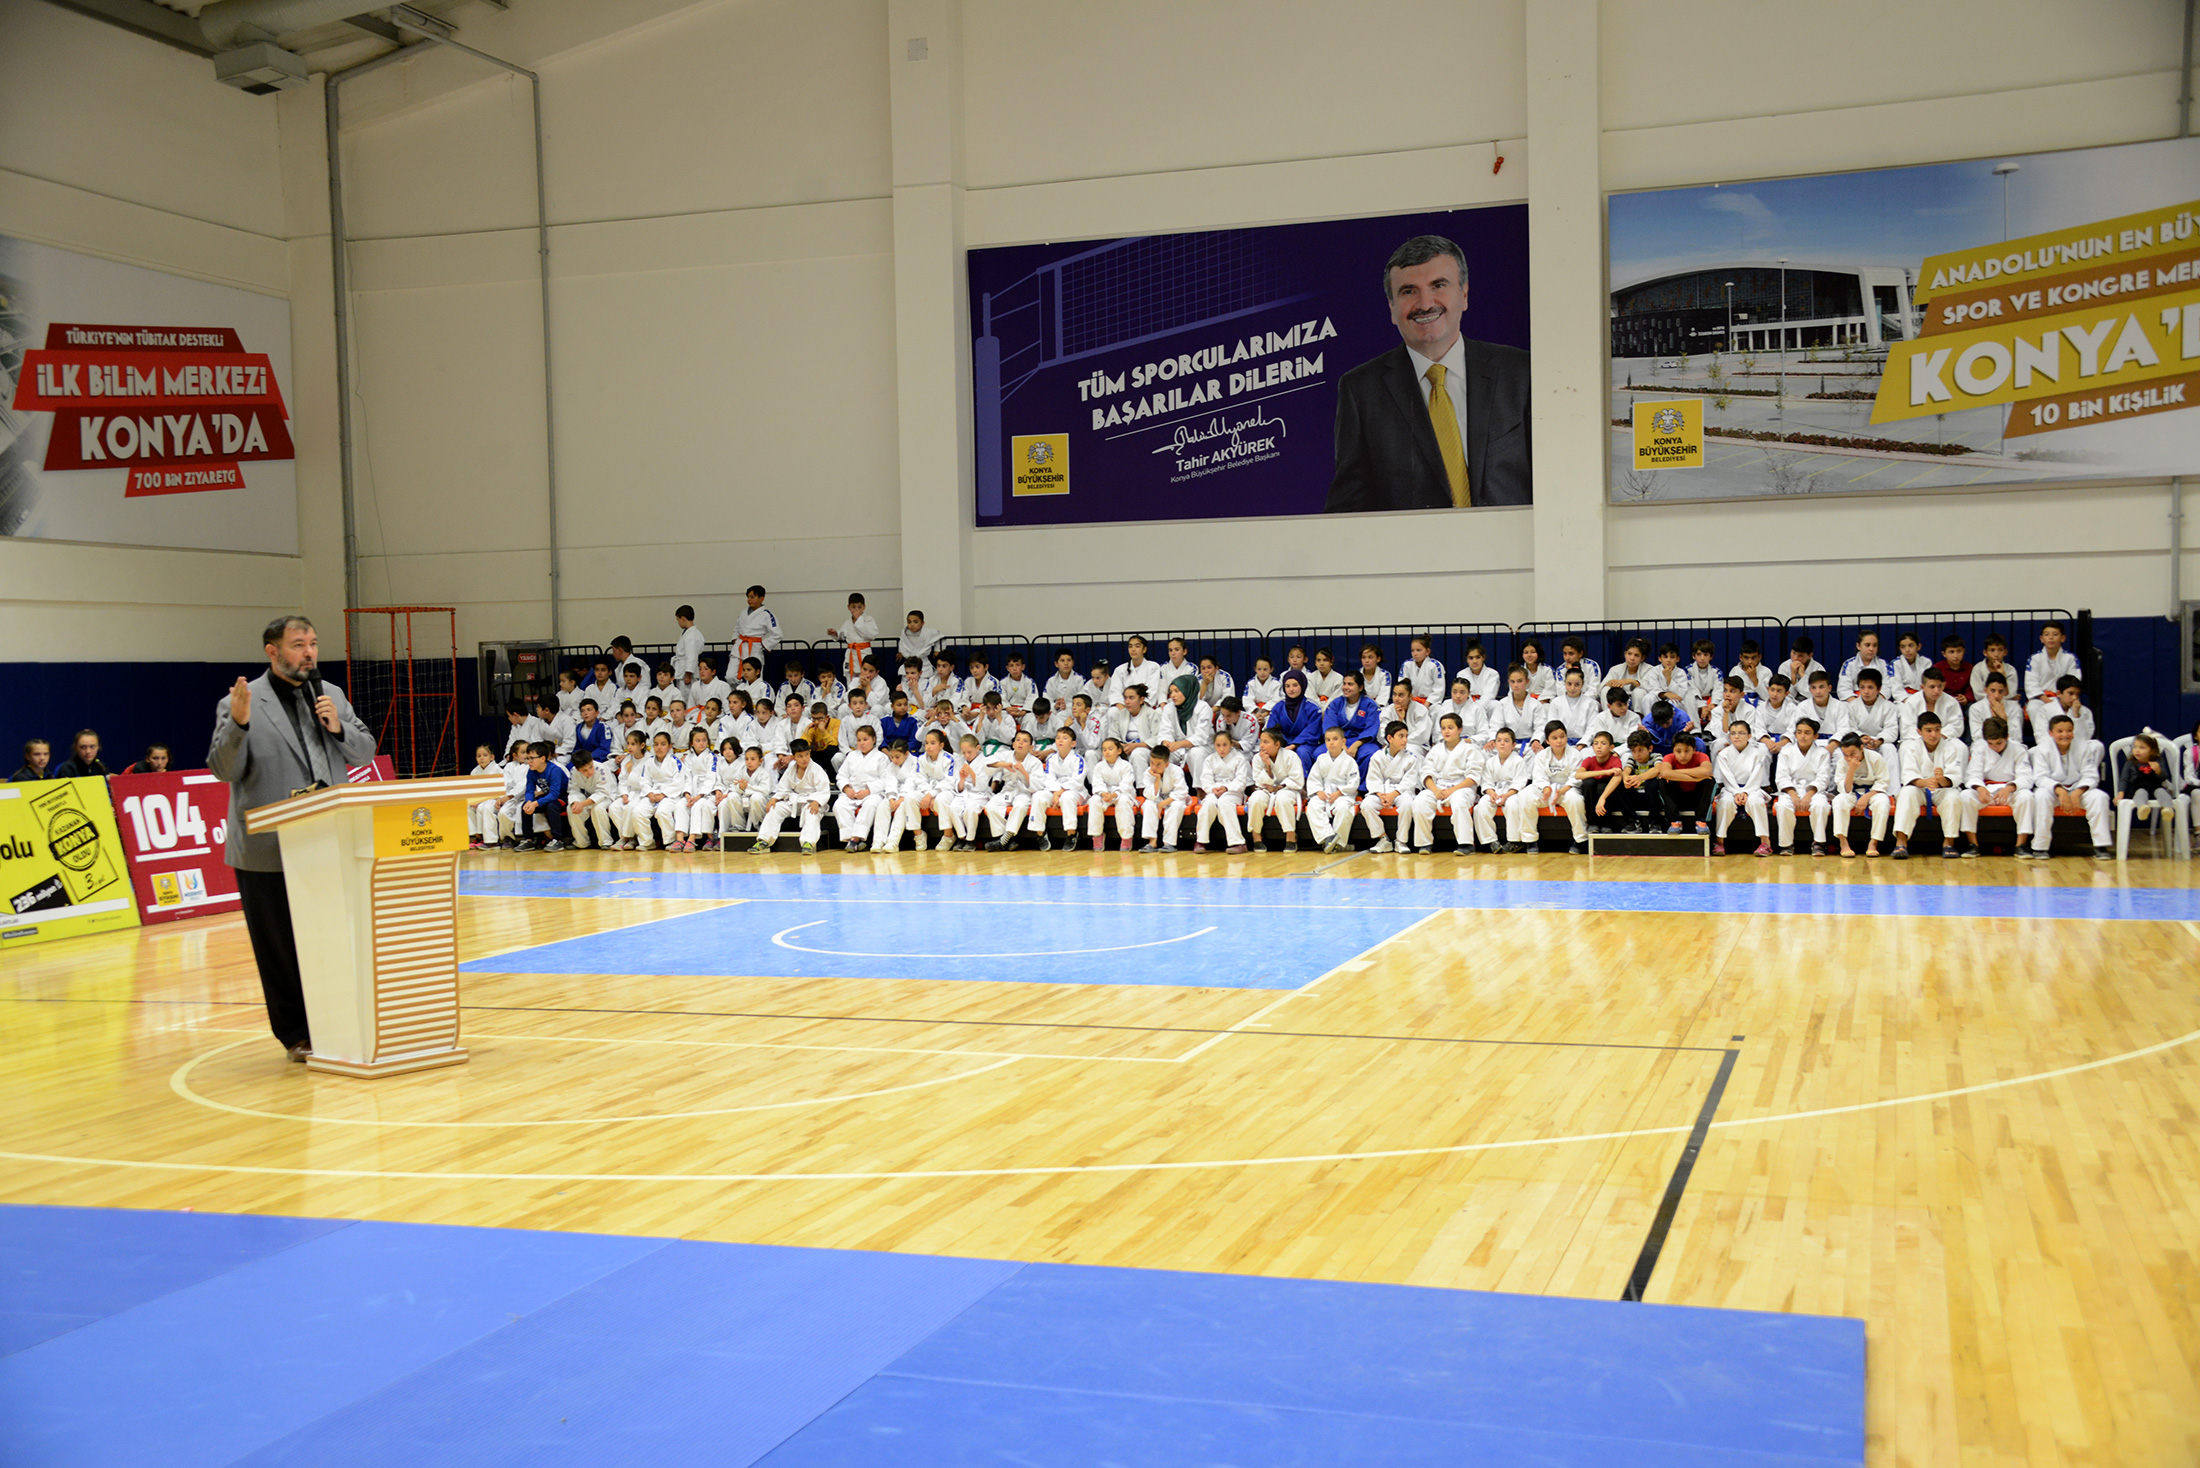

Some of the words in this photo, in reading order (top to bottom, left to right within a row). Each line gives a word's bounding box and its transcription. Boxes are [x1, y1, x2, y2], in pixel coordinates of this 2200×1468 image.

[1930, 235, 2112, 290] ANADOLU'NUN
[2119, 226, 2153, 252] EN
[1943, 298, 2003, 326] SPOR
[2009, 291, 2042, 312] VE
[2048, 270, 2149, 307] KONGRE
[66, 327, 134, 346] TÜRKİYE'NİN
[136, 329, 177, 346] TÜBİTAK
[179, 333, 225, 347] DESTEKLİ
[1078, 370, 1125, 402] TÜM
[1131, 316, 1338, 388] SPORCULARIMIZA
[37, 363, 82, 396] İLK
[88, 364, 157, 396] BİLİM
[163, 365, 267, 396] MERKEZİ
[1092, 379, 1222, 431] BAŞARILAR
[1229, 352, 1324, 396] DİLERİM
[2030, 403, 2060, 426] 10
[2068, 398, 2102, 421] BİN
[2108, 383, 2186, 413] KİŞİLİK
[80, 411, 269, 461] KONYA'DA
[1639, 444, 1698, 456] BÜYÜKŞEHİR
[1654, 437, 1683, 446] KONYA
[1170, 473, 1190, 483] Konya
[1191, 464, 1226, 478] Büyükşehir
[1227, 458, 1254, 470] Belediye
[1254, 451, 1280, 463] Başkanı
[1176, 454, 1209, 472] Tahir
[1211, 436, 1276, 464] AKYÜREK
[1651, 455, 1686, 463] BELEDİYESİ
[134, 472, 162, 490] 700
[165, 473, 182, 487] BİN
[1017, 473, 1065, 484] BÜYÜKŞEHİR
[123, 791, 207, 853] 104
[0, 835, 34, 861] olu
[54, 825, 96, 857] KONYA
[401, 835, 443, 847] BÜYÜKŞEHİR
[13, 891, 37, 913] 236
